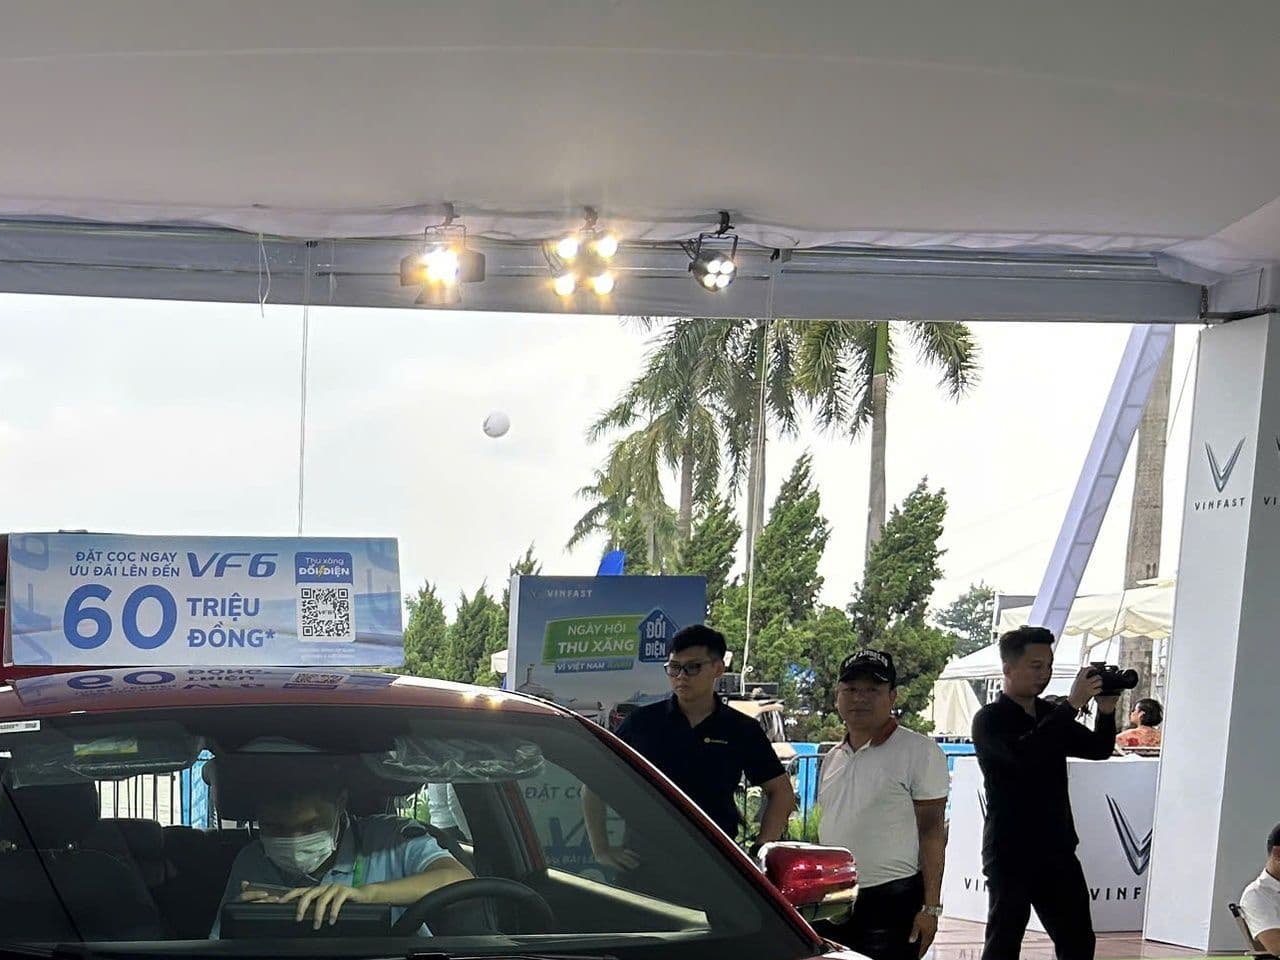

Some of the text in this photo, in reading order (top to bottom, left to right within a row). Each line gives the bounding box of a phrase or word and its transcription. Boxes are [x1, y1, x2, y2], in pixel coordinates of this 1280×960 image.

[1194, 496, 1246, 511] VINFAST
[69, 562, 180, 577] ƯU ĐÃI LÊN ĐẾN
[75, 549, 278, 578] ĐẶT CỌC NGAY VF6
[546, 589, 594, 598] VINFAST
[63, 584, 260, 650] 60 TRIỆU
[568, 622, 602, 635] NGÀY
[646, 615, 666, 639] ĐỔI
[558, 637, 635, 654] THU XĂNG
[645, 642, 666, 658] ĐIỆN
[1090, 886, 1142, 901] VINF
